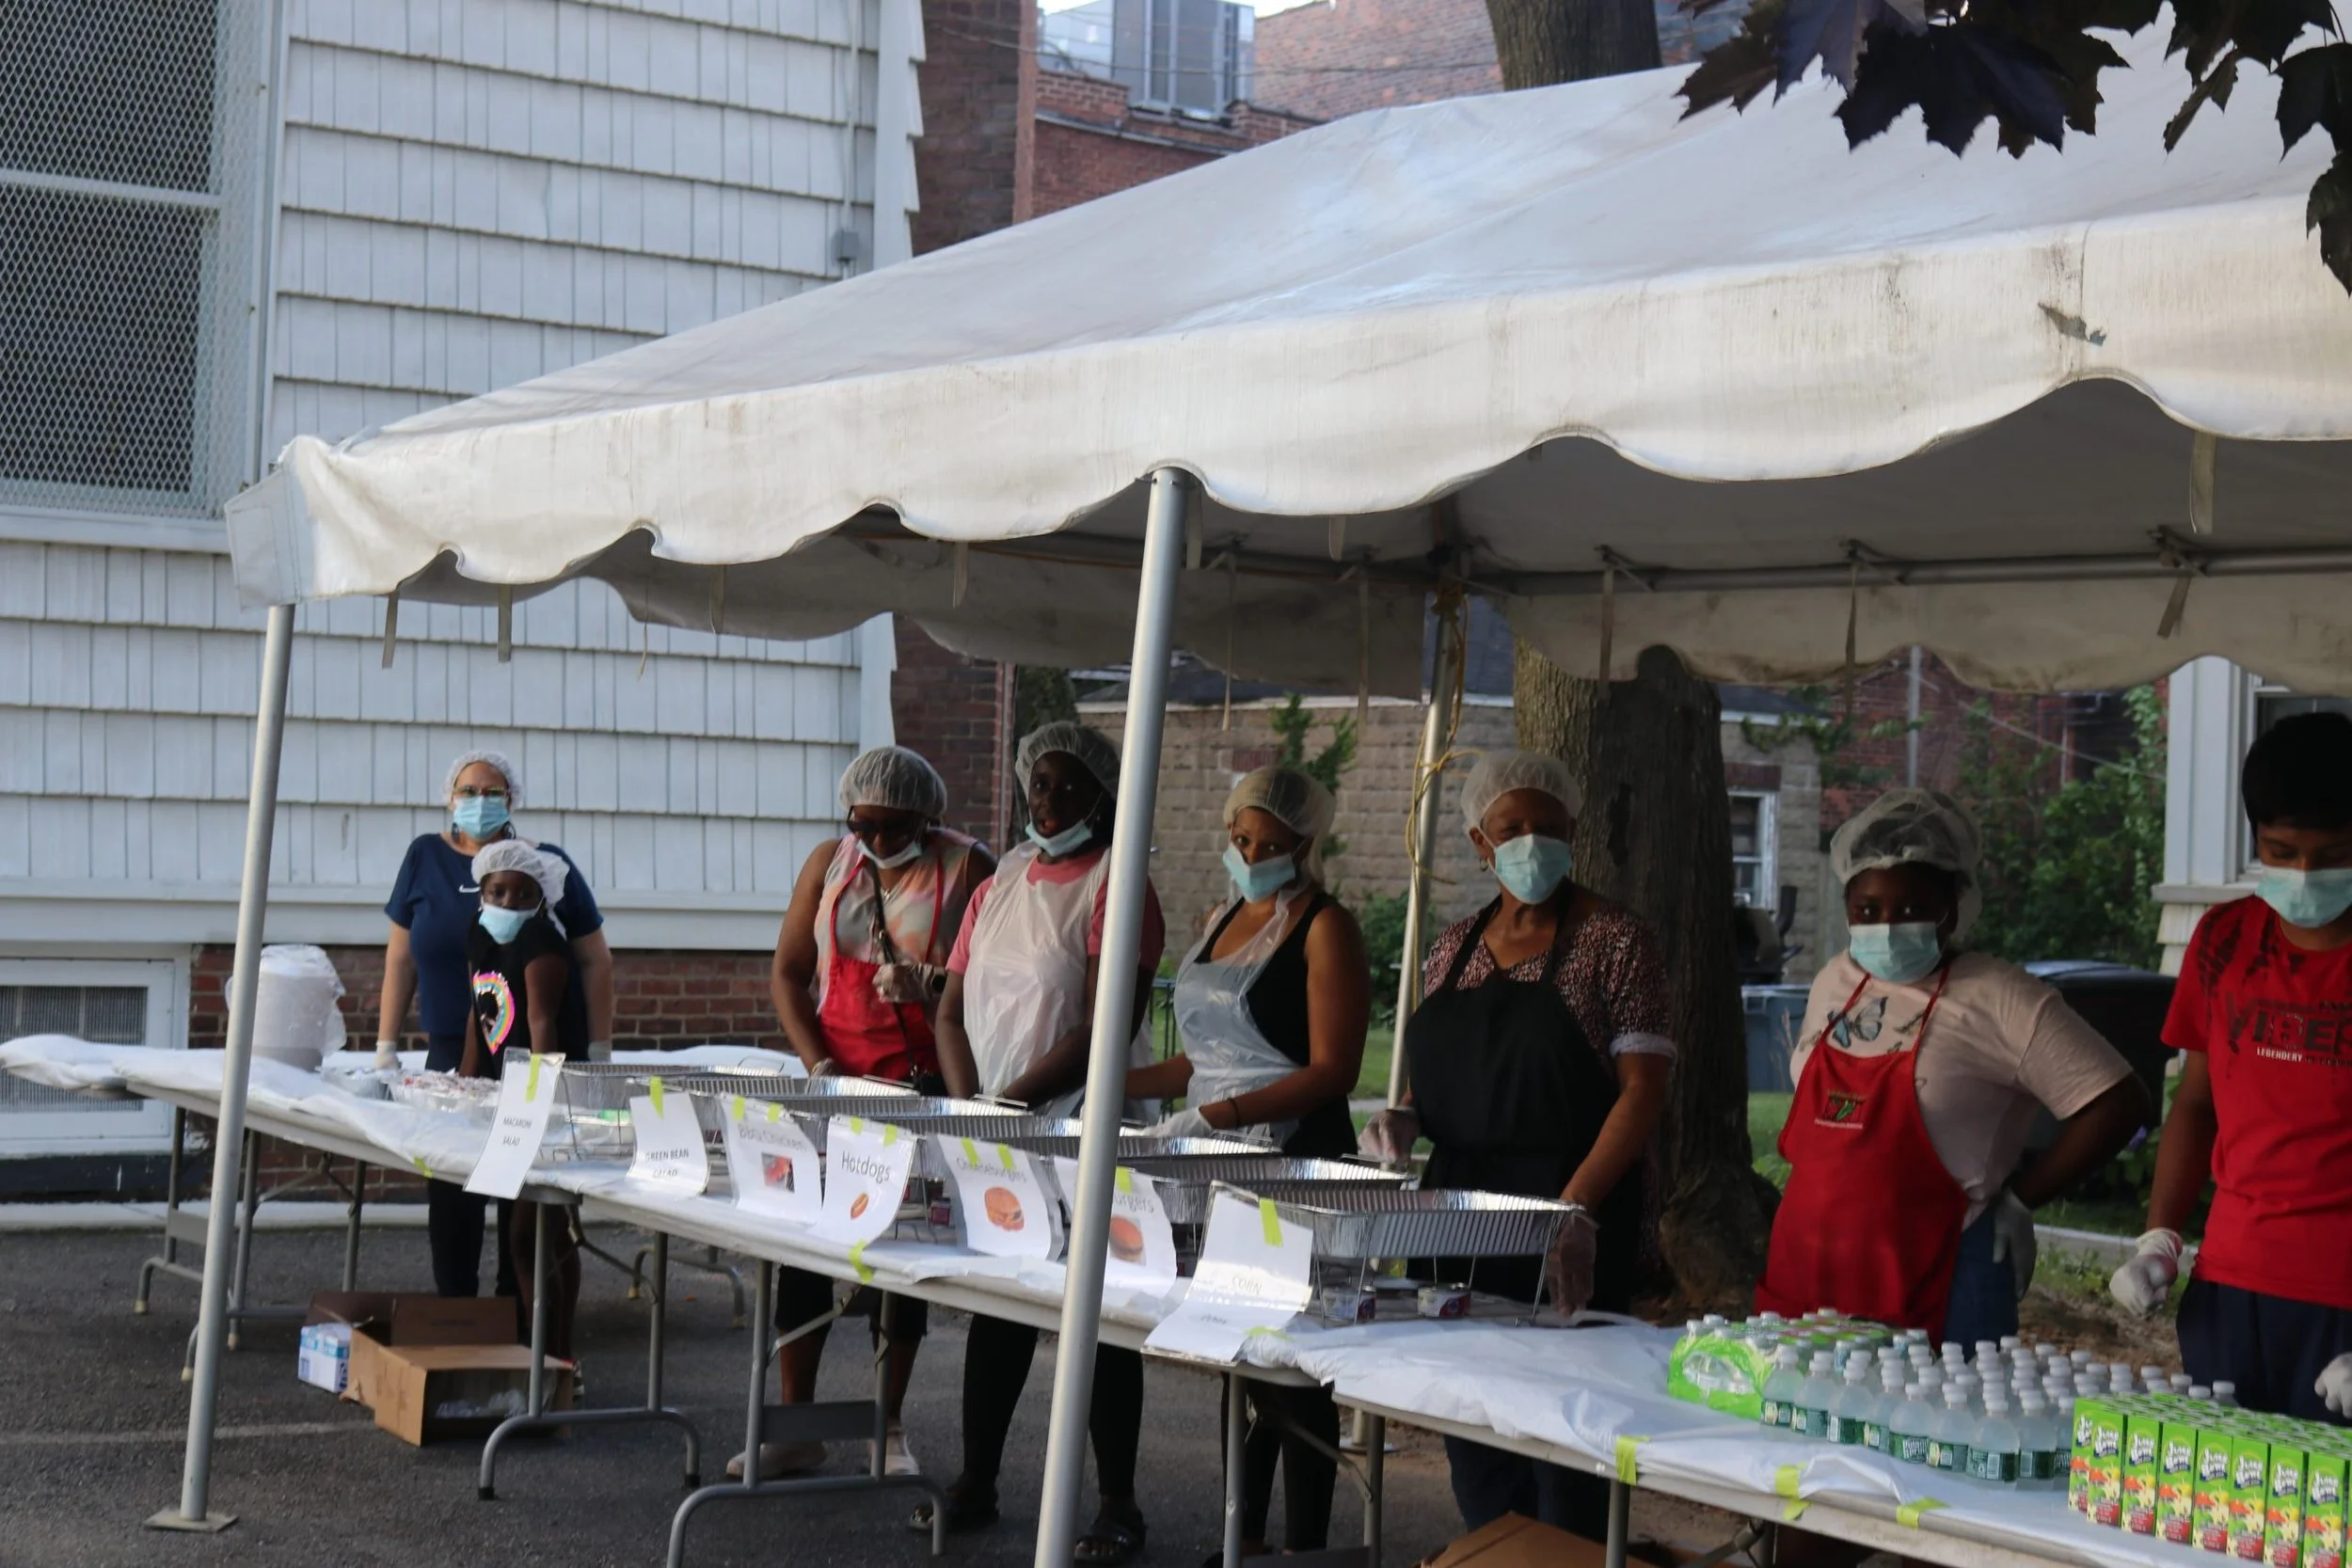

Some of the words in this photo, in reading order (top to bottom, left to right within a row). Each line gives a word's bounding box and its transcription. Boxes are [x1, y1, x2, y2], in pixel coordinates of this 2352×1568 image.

[645, 1149, 669, 1163] GREEN
[670, 1147, 690, 1161] BEAN
[841, 1150, 892, 1184] Hotdogs
